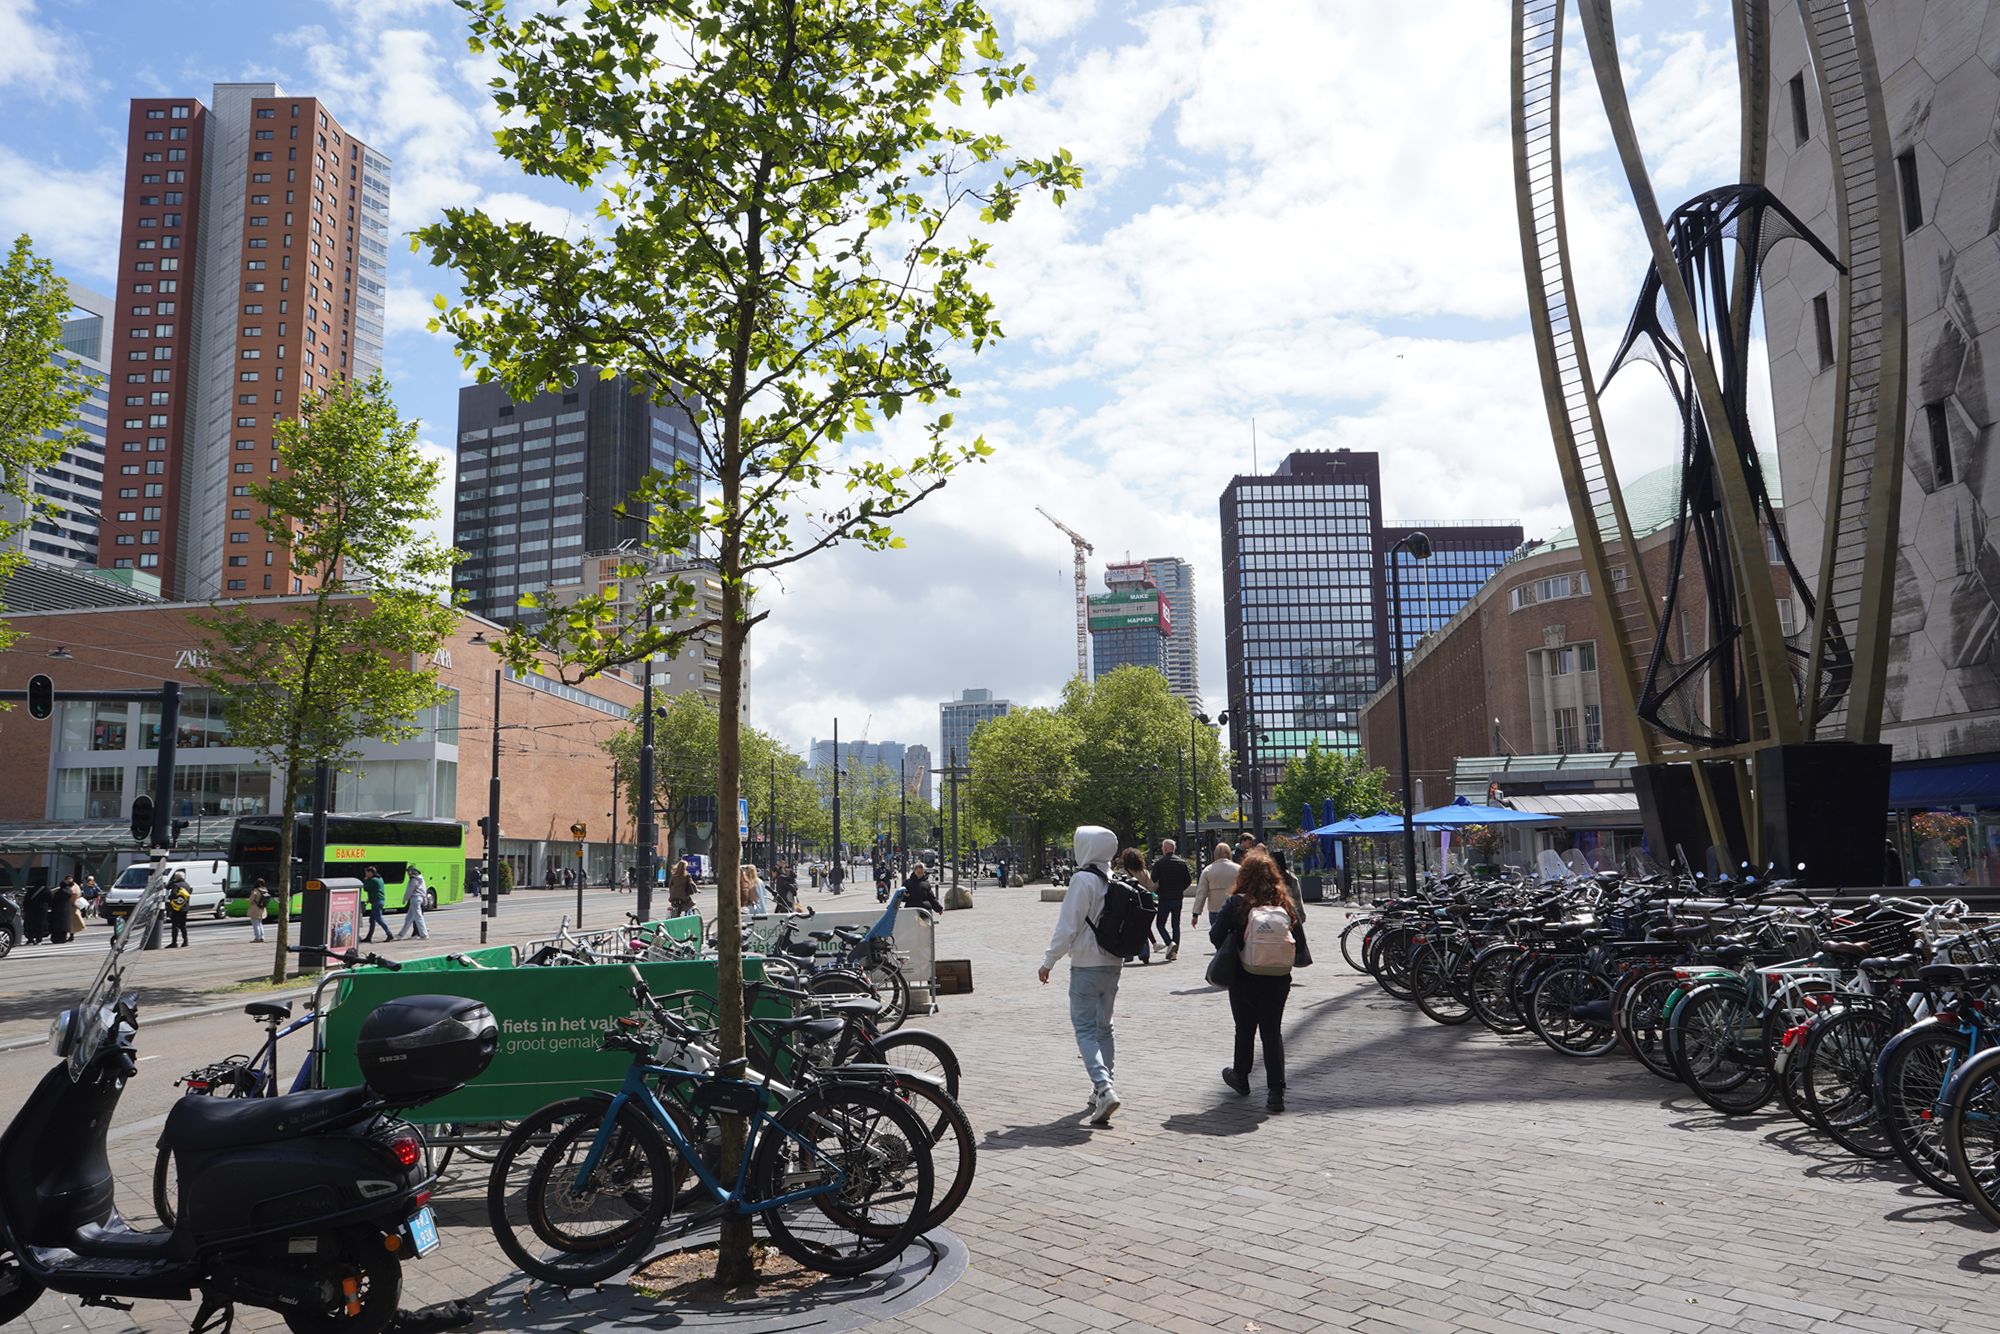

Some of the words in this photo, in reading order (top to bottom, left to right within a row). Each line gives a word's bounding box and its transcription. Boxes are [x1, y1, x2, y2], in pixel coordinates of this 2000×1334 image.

[335, 847, 366, 859] BAKKER
[503, 1019, 538, 1034] fiets
[541, 1018, 556, 1032] in
[560, 1017, 587, 1031] het
[590, 1015, 618, 1030] vak
[507, 1036, 545, 1055] groot
[549, 1034, 600, 1053] gemak
